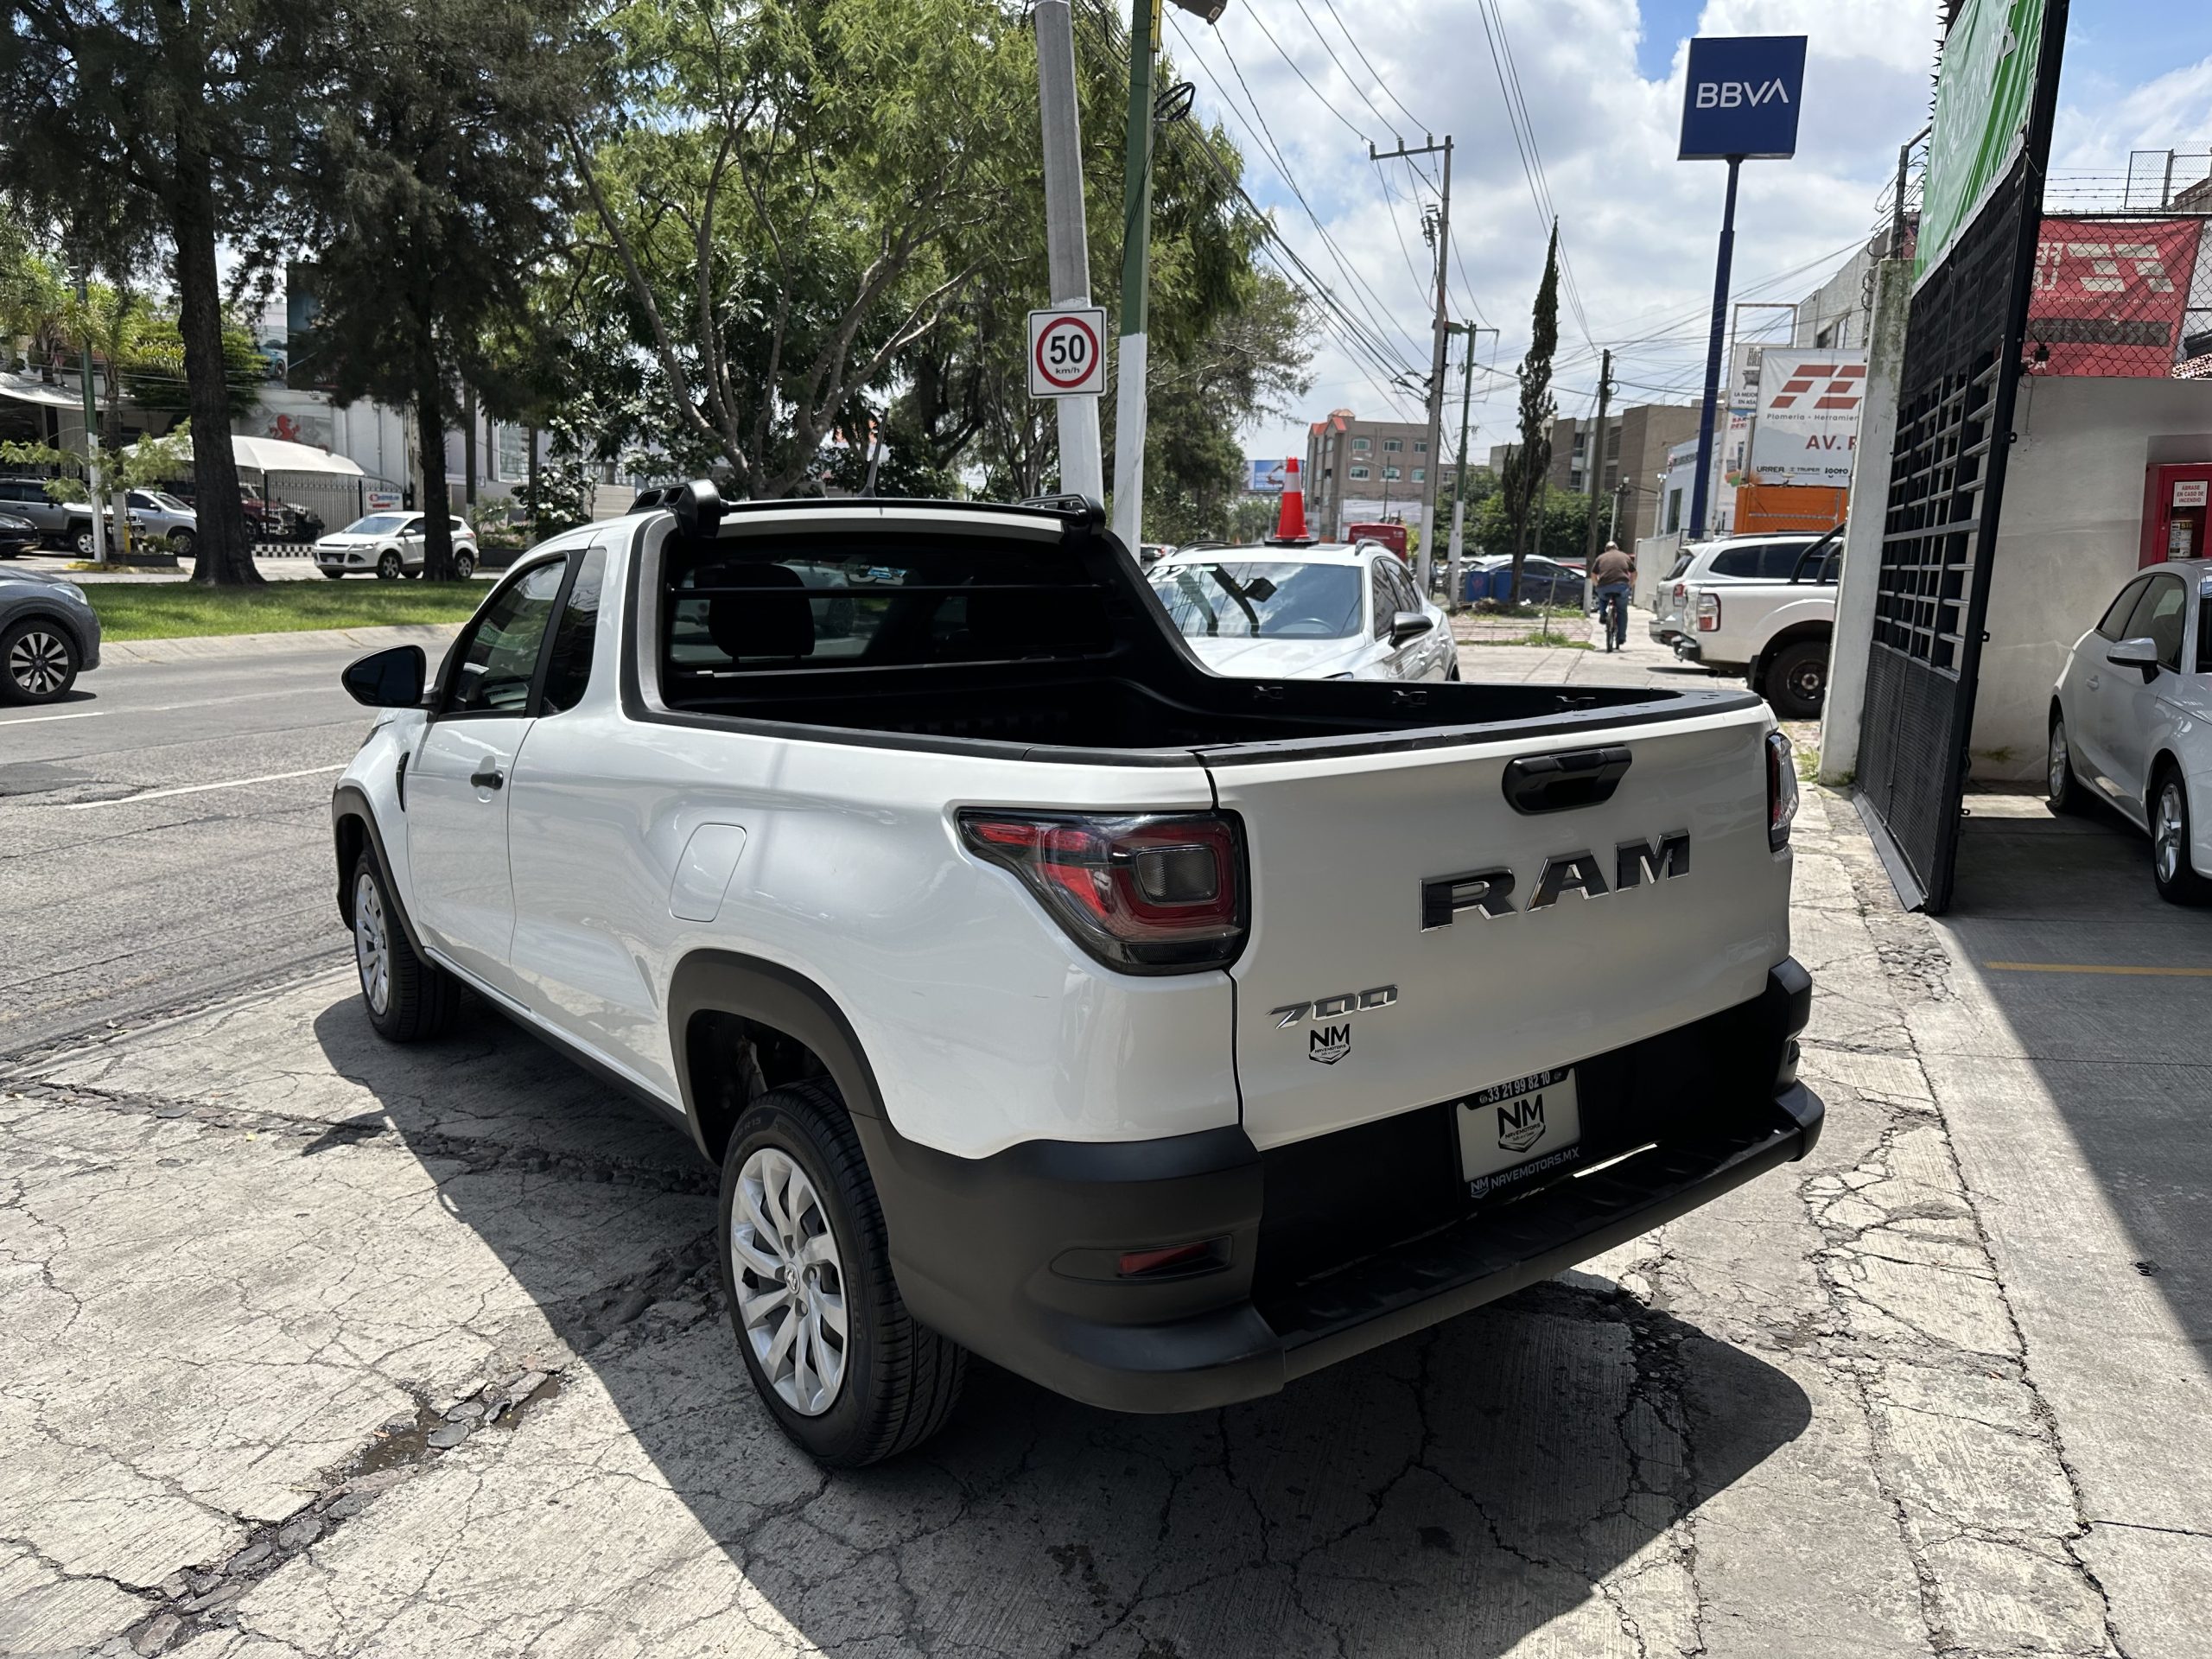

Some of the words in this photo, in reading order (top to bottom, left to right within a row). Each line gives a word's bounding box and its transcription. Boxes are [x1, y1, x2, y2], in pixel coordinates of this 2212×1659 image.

[1696, 78, 1789, 108] BBVA
[1050, 334, 1085, 365] 50
[1055, 366, 1080, 375] km/h
[1805, 435, 1841, 450] AV.
[1420, 828, 1690, 933] RAM
[1265, 984, 1398, 1030] 700
[1310, 1023, 1351, 1053] NM
[1488, 1086, 1500, 1103] 33
[1502, 1083, 1513, 1098] 21
[1514, 1078, 1526, 1095] 99
[1528, 1073, 1540, 1090] 82
[1541, 1071, 1550, 1085] 10
[1497, 1093, 1545, 1141] NM
[1505, 1122, 1541, 1140] NAVEMOTORS
[1491, 1147, 1580, 1190] NAVEMOTORS.MX
[1471, 1176, 1489, 1193] NM
